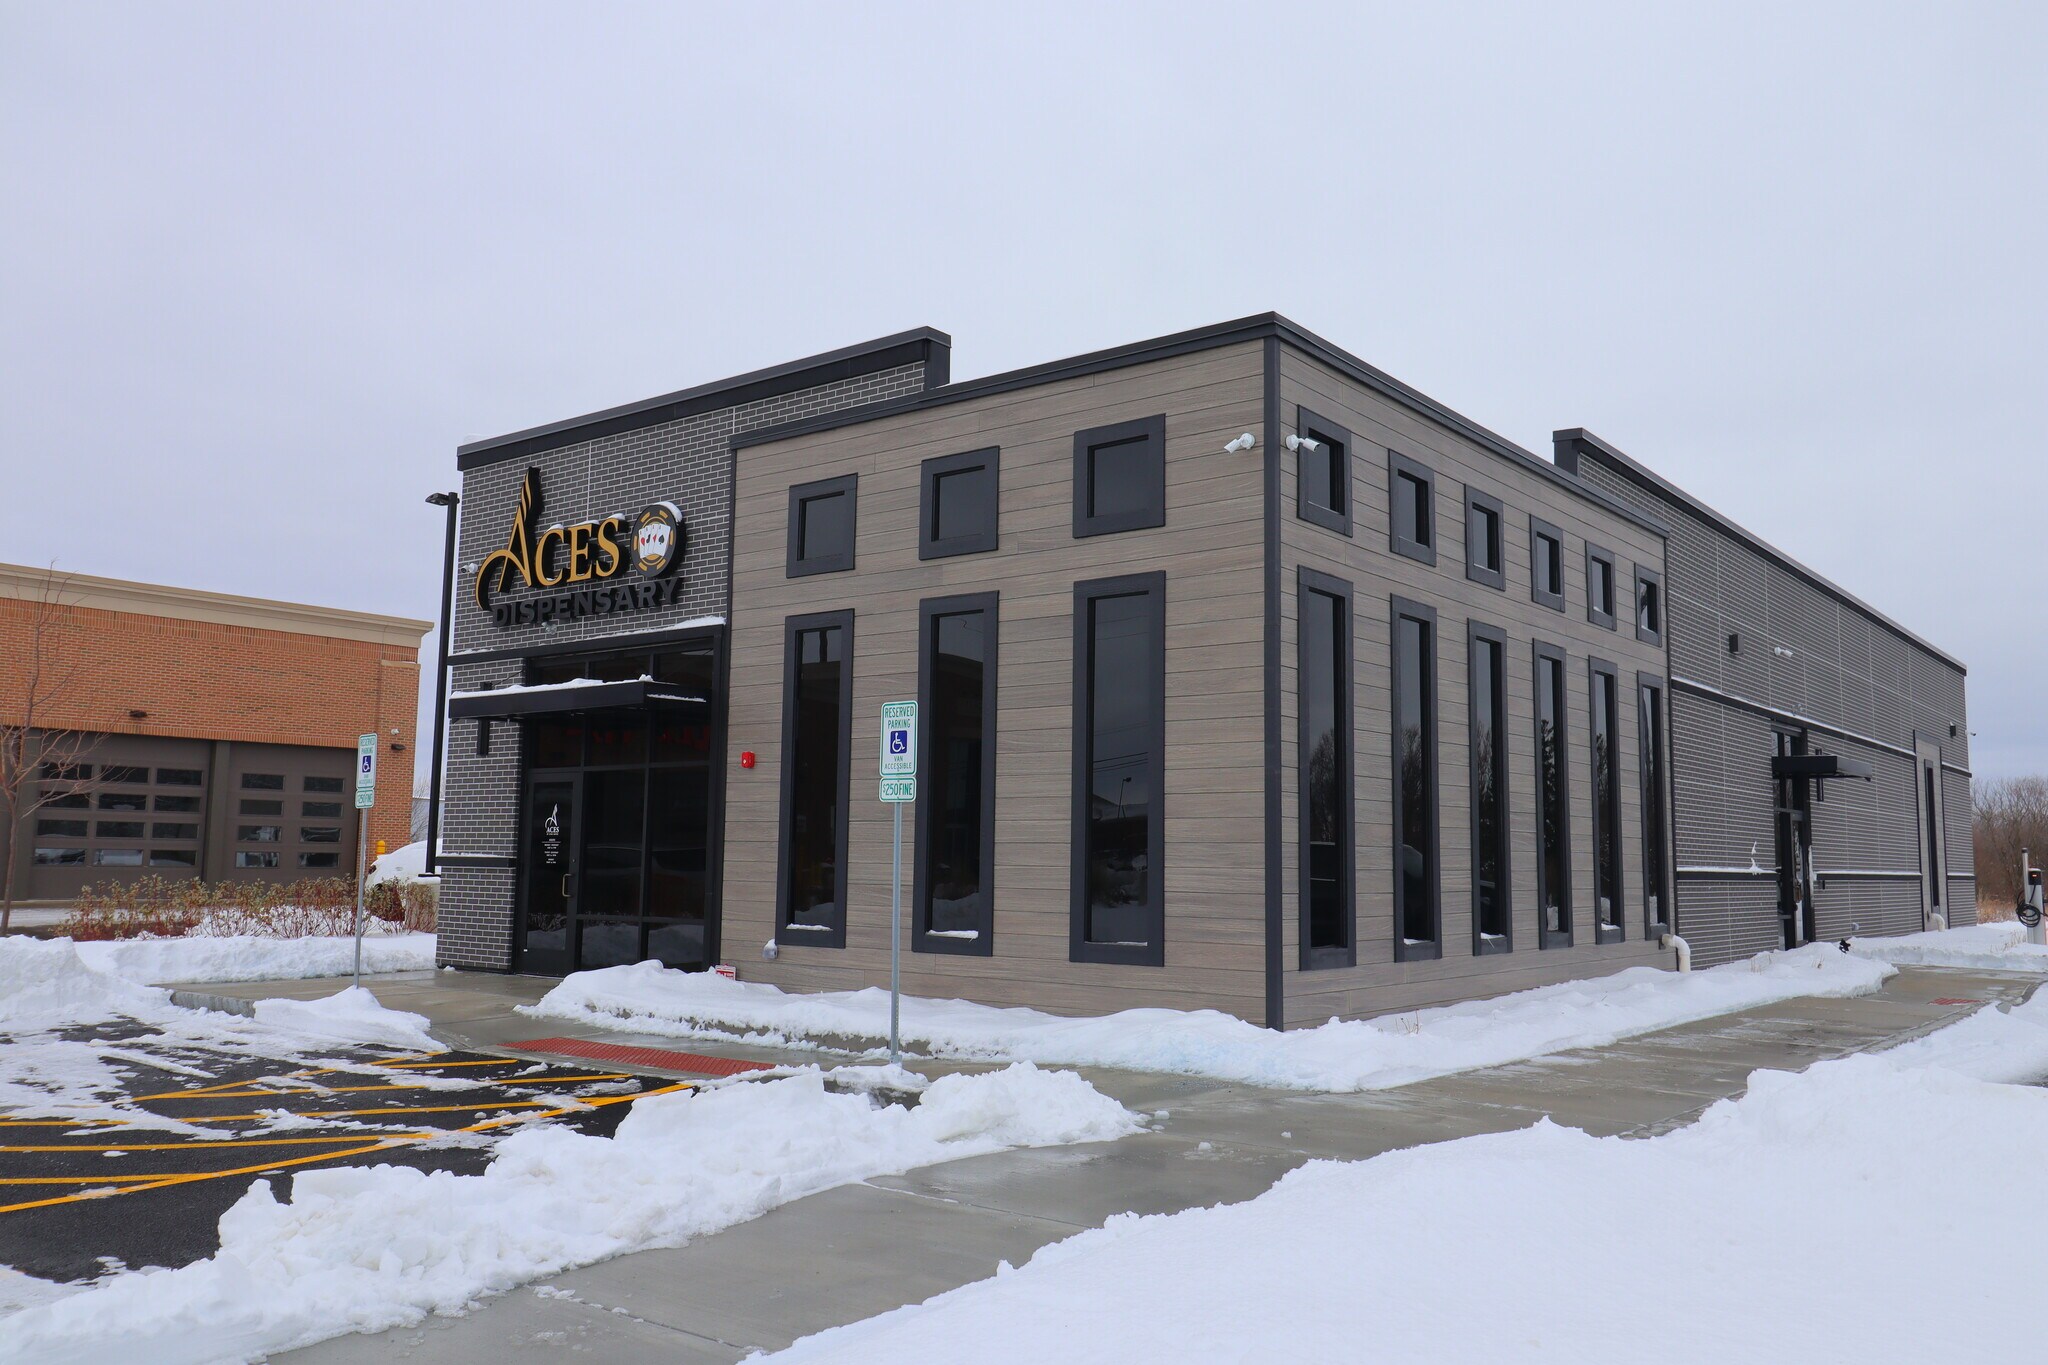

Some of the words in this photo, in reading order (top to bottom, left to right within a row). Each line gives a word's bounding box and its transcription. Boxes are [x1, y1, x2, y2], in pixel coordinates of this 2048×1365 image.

[476, 467, 627, 610] ACES
[493, 577, 682, 627] DISPENSARY
[884, 706, 914, 718] RESERVED
[888, 719, 911, 729] PARKING
[899, 783, 912, 795] FINE
